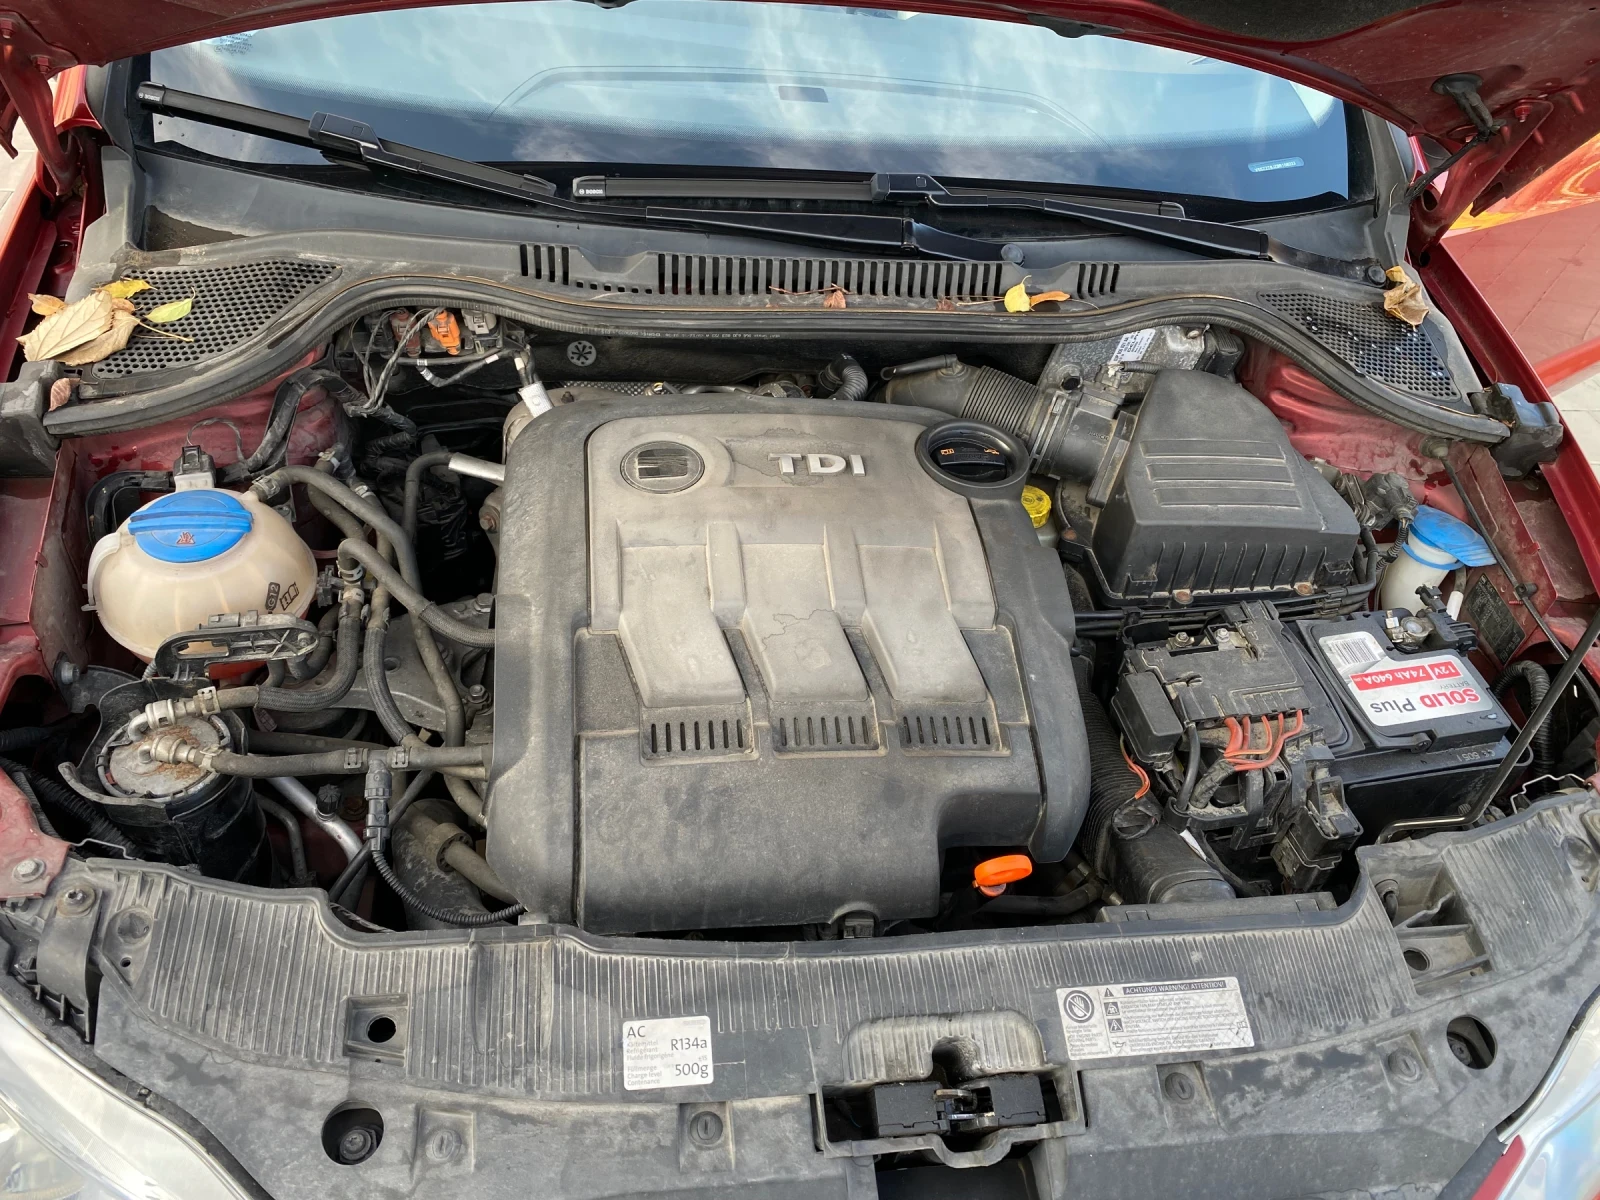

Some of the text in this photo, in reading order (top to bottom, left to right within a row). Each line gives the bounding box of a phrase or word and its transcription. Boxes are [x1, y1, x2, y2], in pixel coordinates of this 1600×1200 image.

[767, 453, 866, 476] TDI
[268, 584, 279, 607] G12
[1394, 667, 1427, 681] 74Ah
[1434, 664, 1456, 676] 12V
[1363, 674, 1393, 684] 640A
[1440, 680, 1470, 690] BATTERY
[1370, 688, 1480, 714] SOLID Plus
[1125, 981, 1225, 994] ACHTUNG! WARNING! ATTENTION!
[626, 1025, 646, 1039] AC
[670, 1037, 708, 1051] R134a
[675, 1062, 709, 1079] 500g
